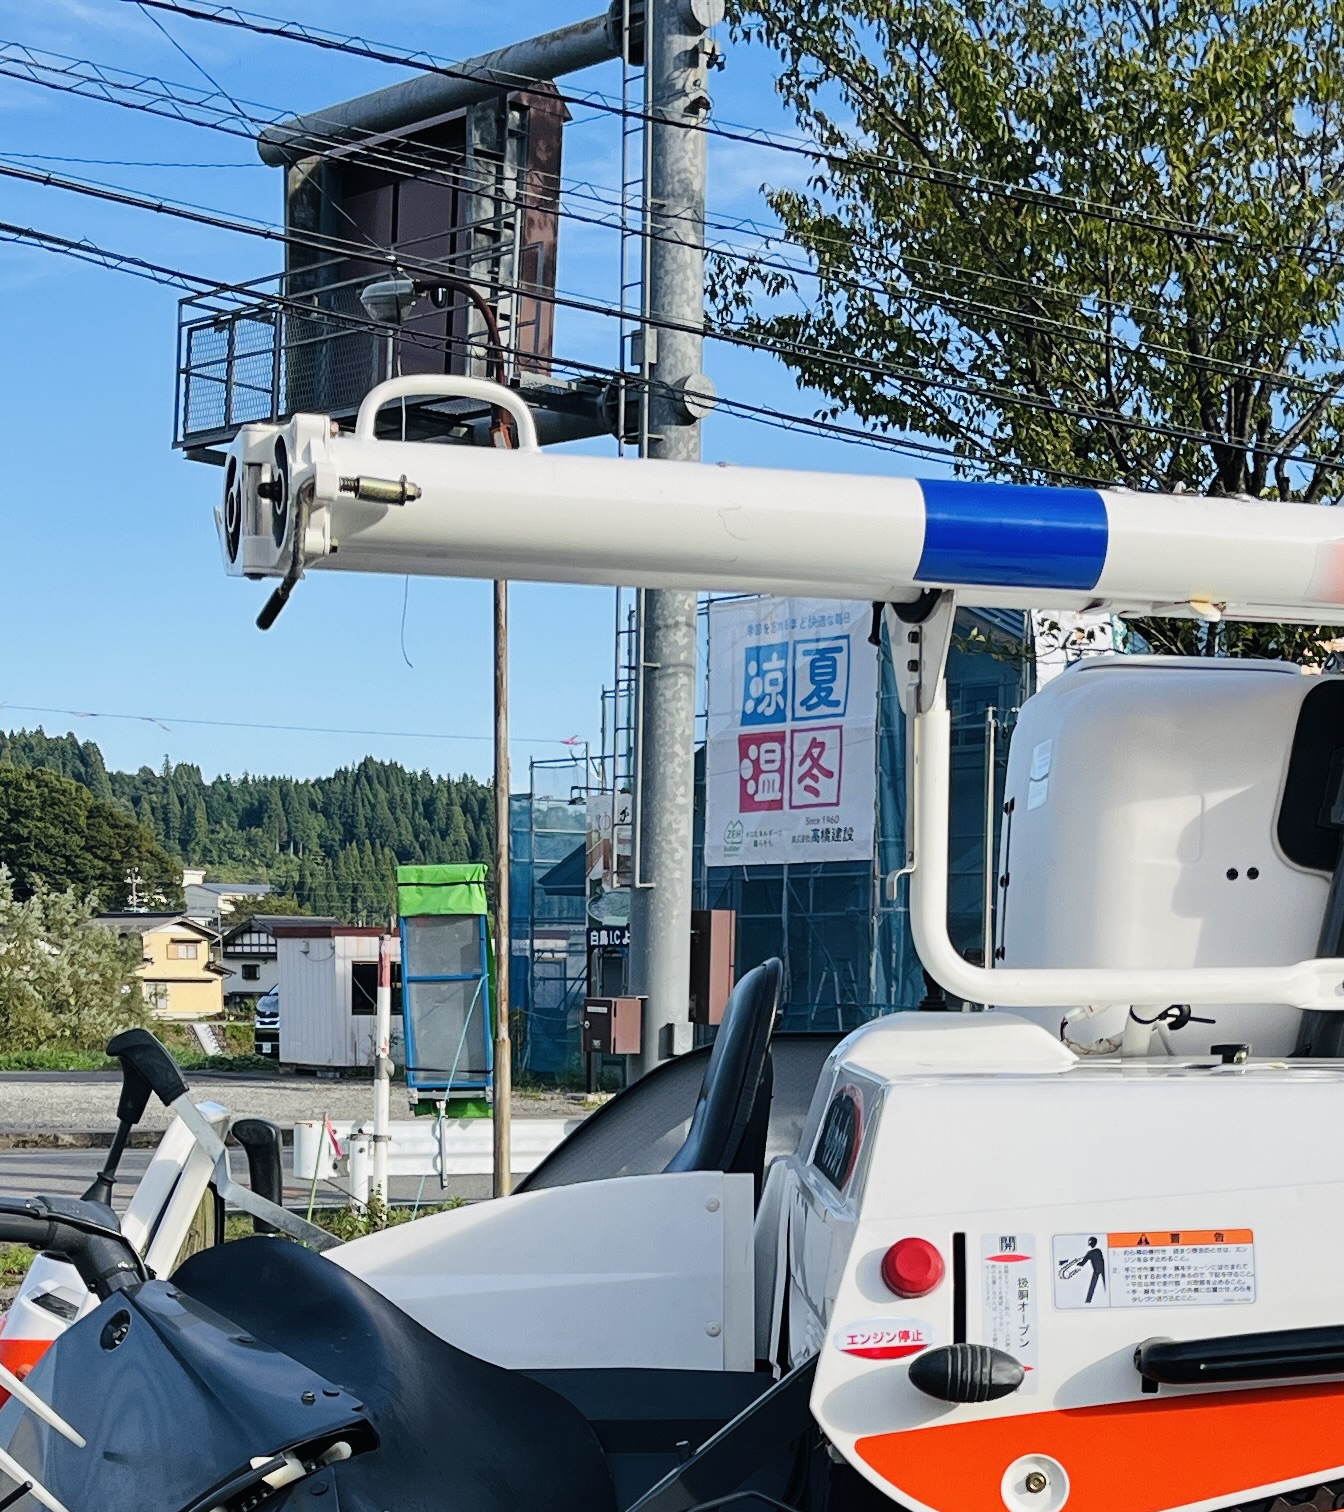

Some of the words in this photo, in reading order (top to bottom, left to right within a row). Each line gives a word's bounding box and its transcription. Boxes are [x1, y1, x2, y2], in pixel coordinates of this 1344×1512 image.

[745, 652, 785, 716] 涼
[801, 645, 843, 712] 夏
[741, 742, 783, 803] 温
[797, 736, 835, 799] 冬
[1000, 1235, 1017, 1252] 開
[846, 1329, 924, 1346] エンジン停止
